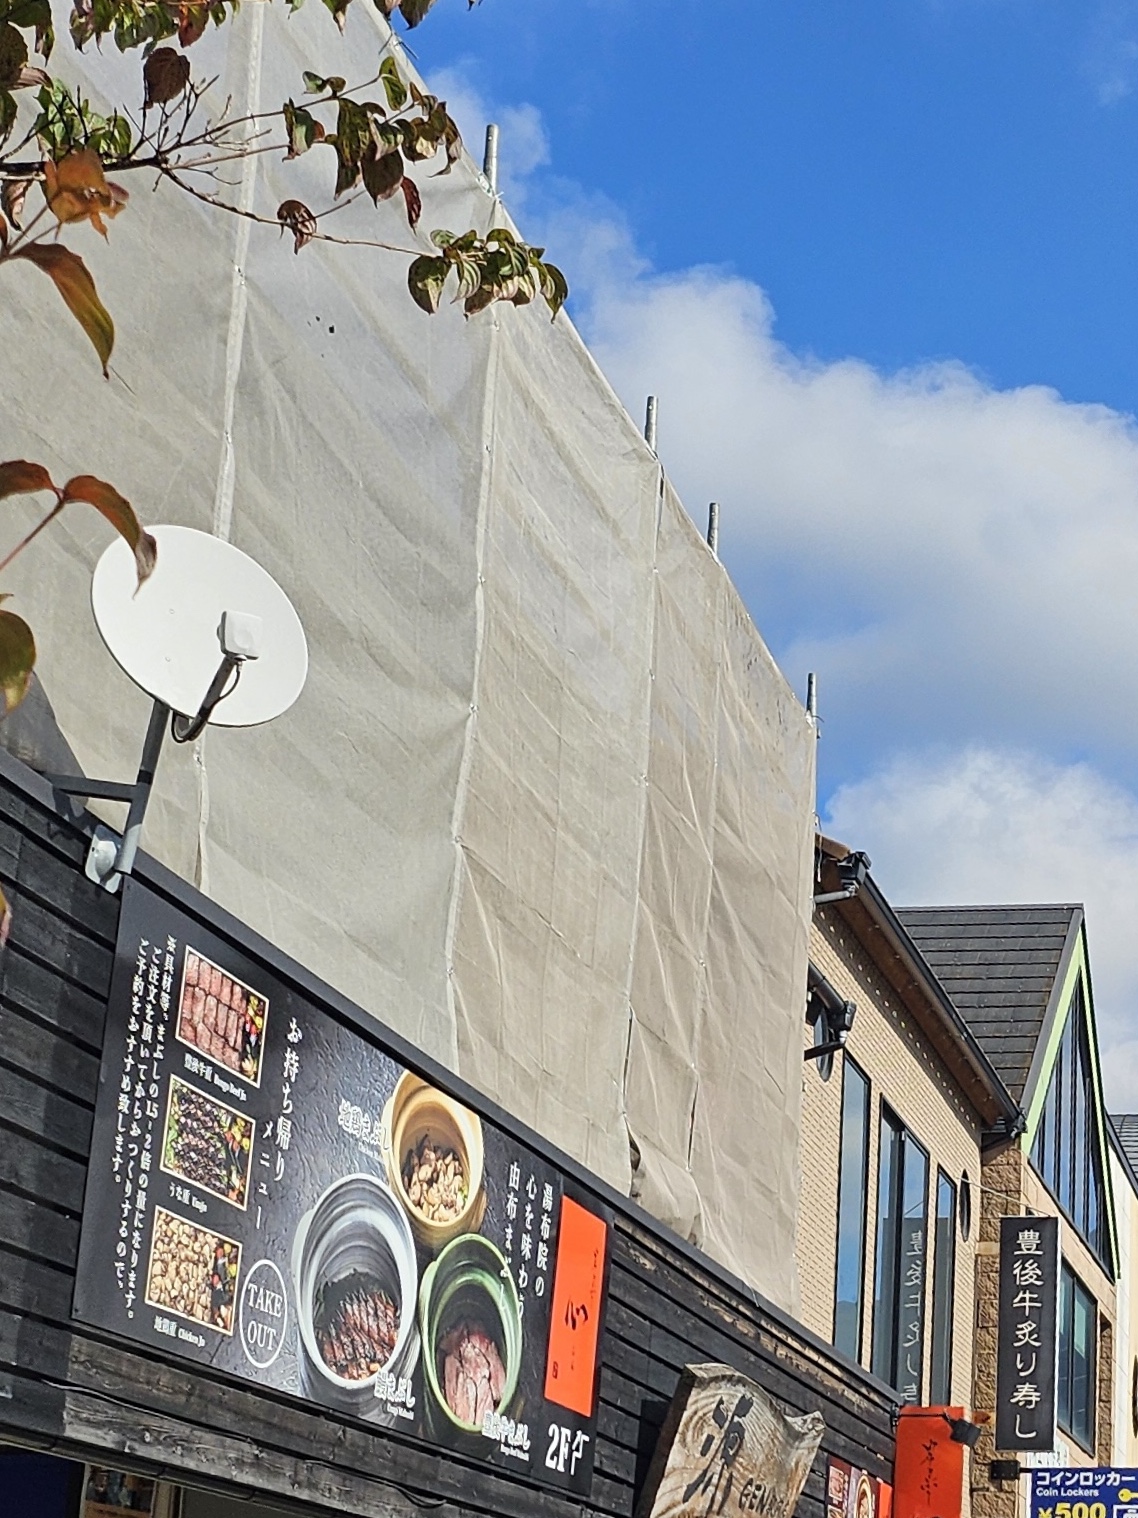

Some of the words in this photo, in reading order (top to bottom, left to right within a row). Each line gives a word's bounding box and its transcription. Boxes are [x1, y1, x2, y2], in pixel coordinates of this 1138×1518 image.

[274, 1017, 302, 1182] お持ち帰り
[255, 1120, 274, 1230] メニュー
[535, 1182, 554, 1297] 湯布院の
[248, 1283, 283, 1318] TAKE
[249, 1320, 277, 1351] OUT
[1009, 1229, 1045, 1440] 豊後牛炙り寿し
[545, 1423, 571, 1473] 2F
[1036, 1471, 1136, 1487] コインロッカー
[1036, 1488, 1059, 1497] Coin
[1061, 1488, 1099, 1497] Lockers
